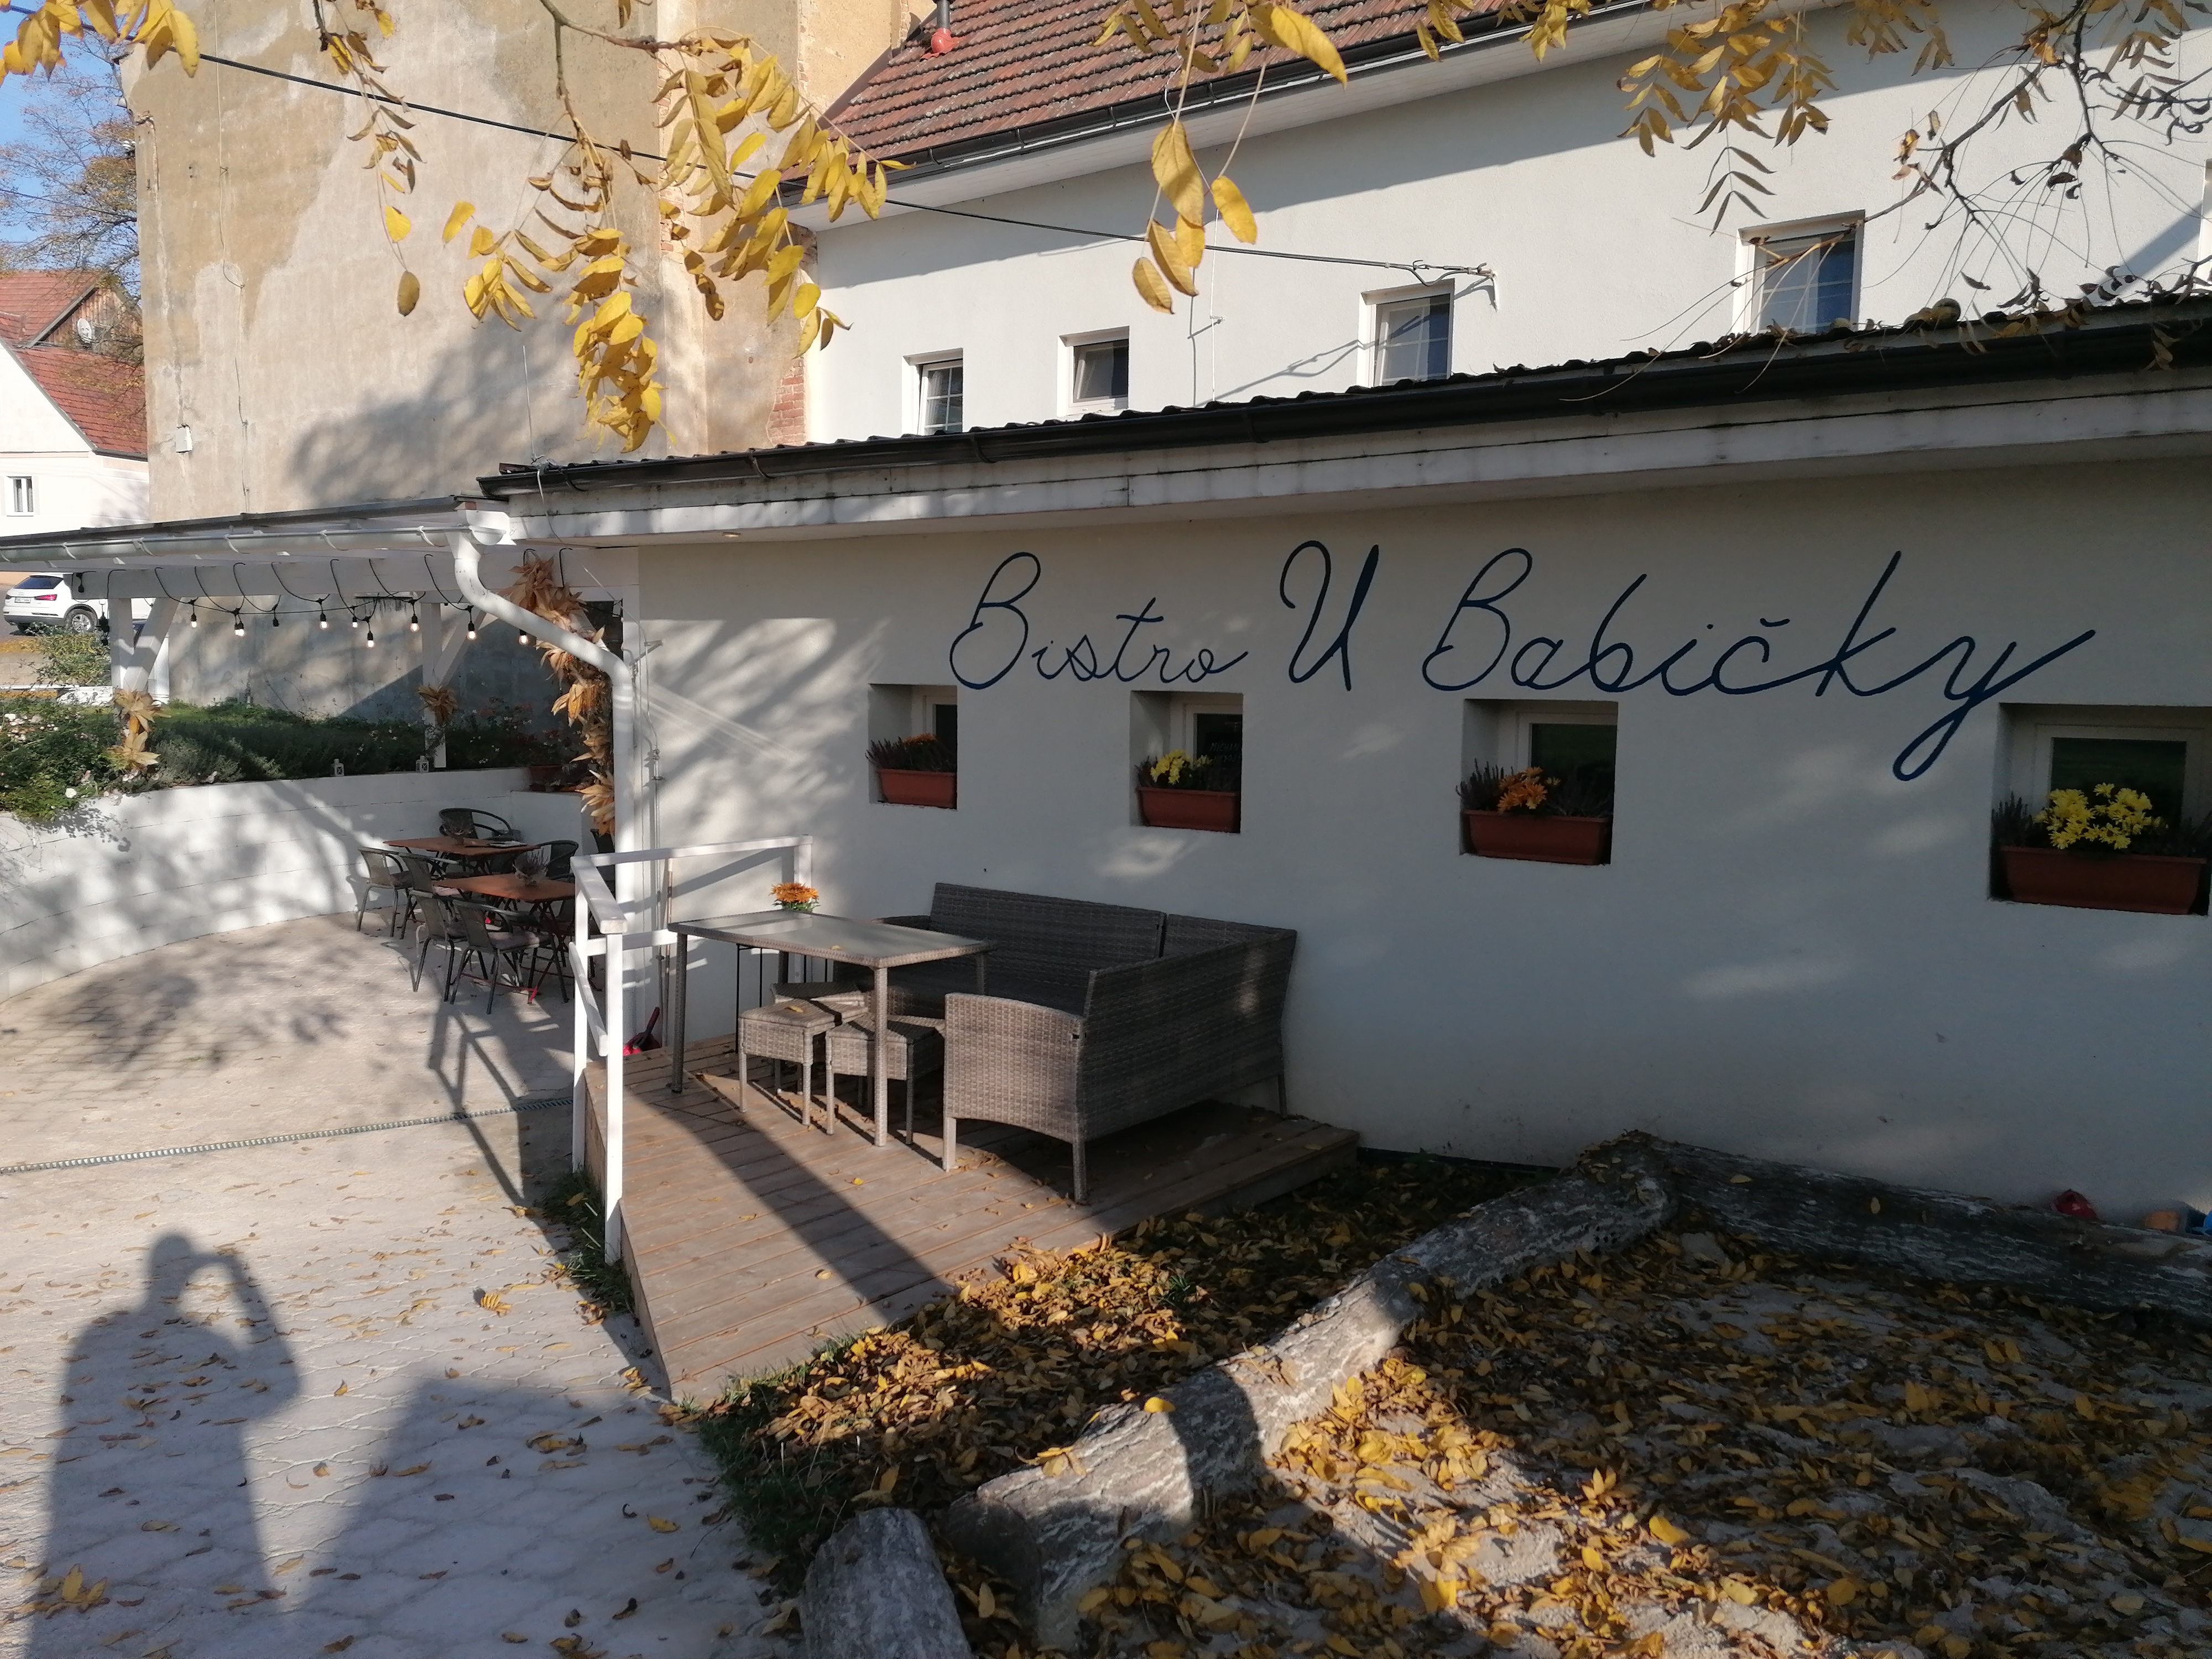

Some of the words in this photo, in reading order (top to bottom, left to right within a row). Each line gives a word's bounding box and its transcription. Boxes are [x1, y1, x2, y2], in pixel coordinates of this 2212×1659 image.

[950, 551, 1249, 689] Bistro
[1280, 540, 1379, 691] U
[1422, 547, 2096, 782] Babičky
